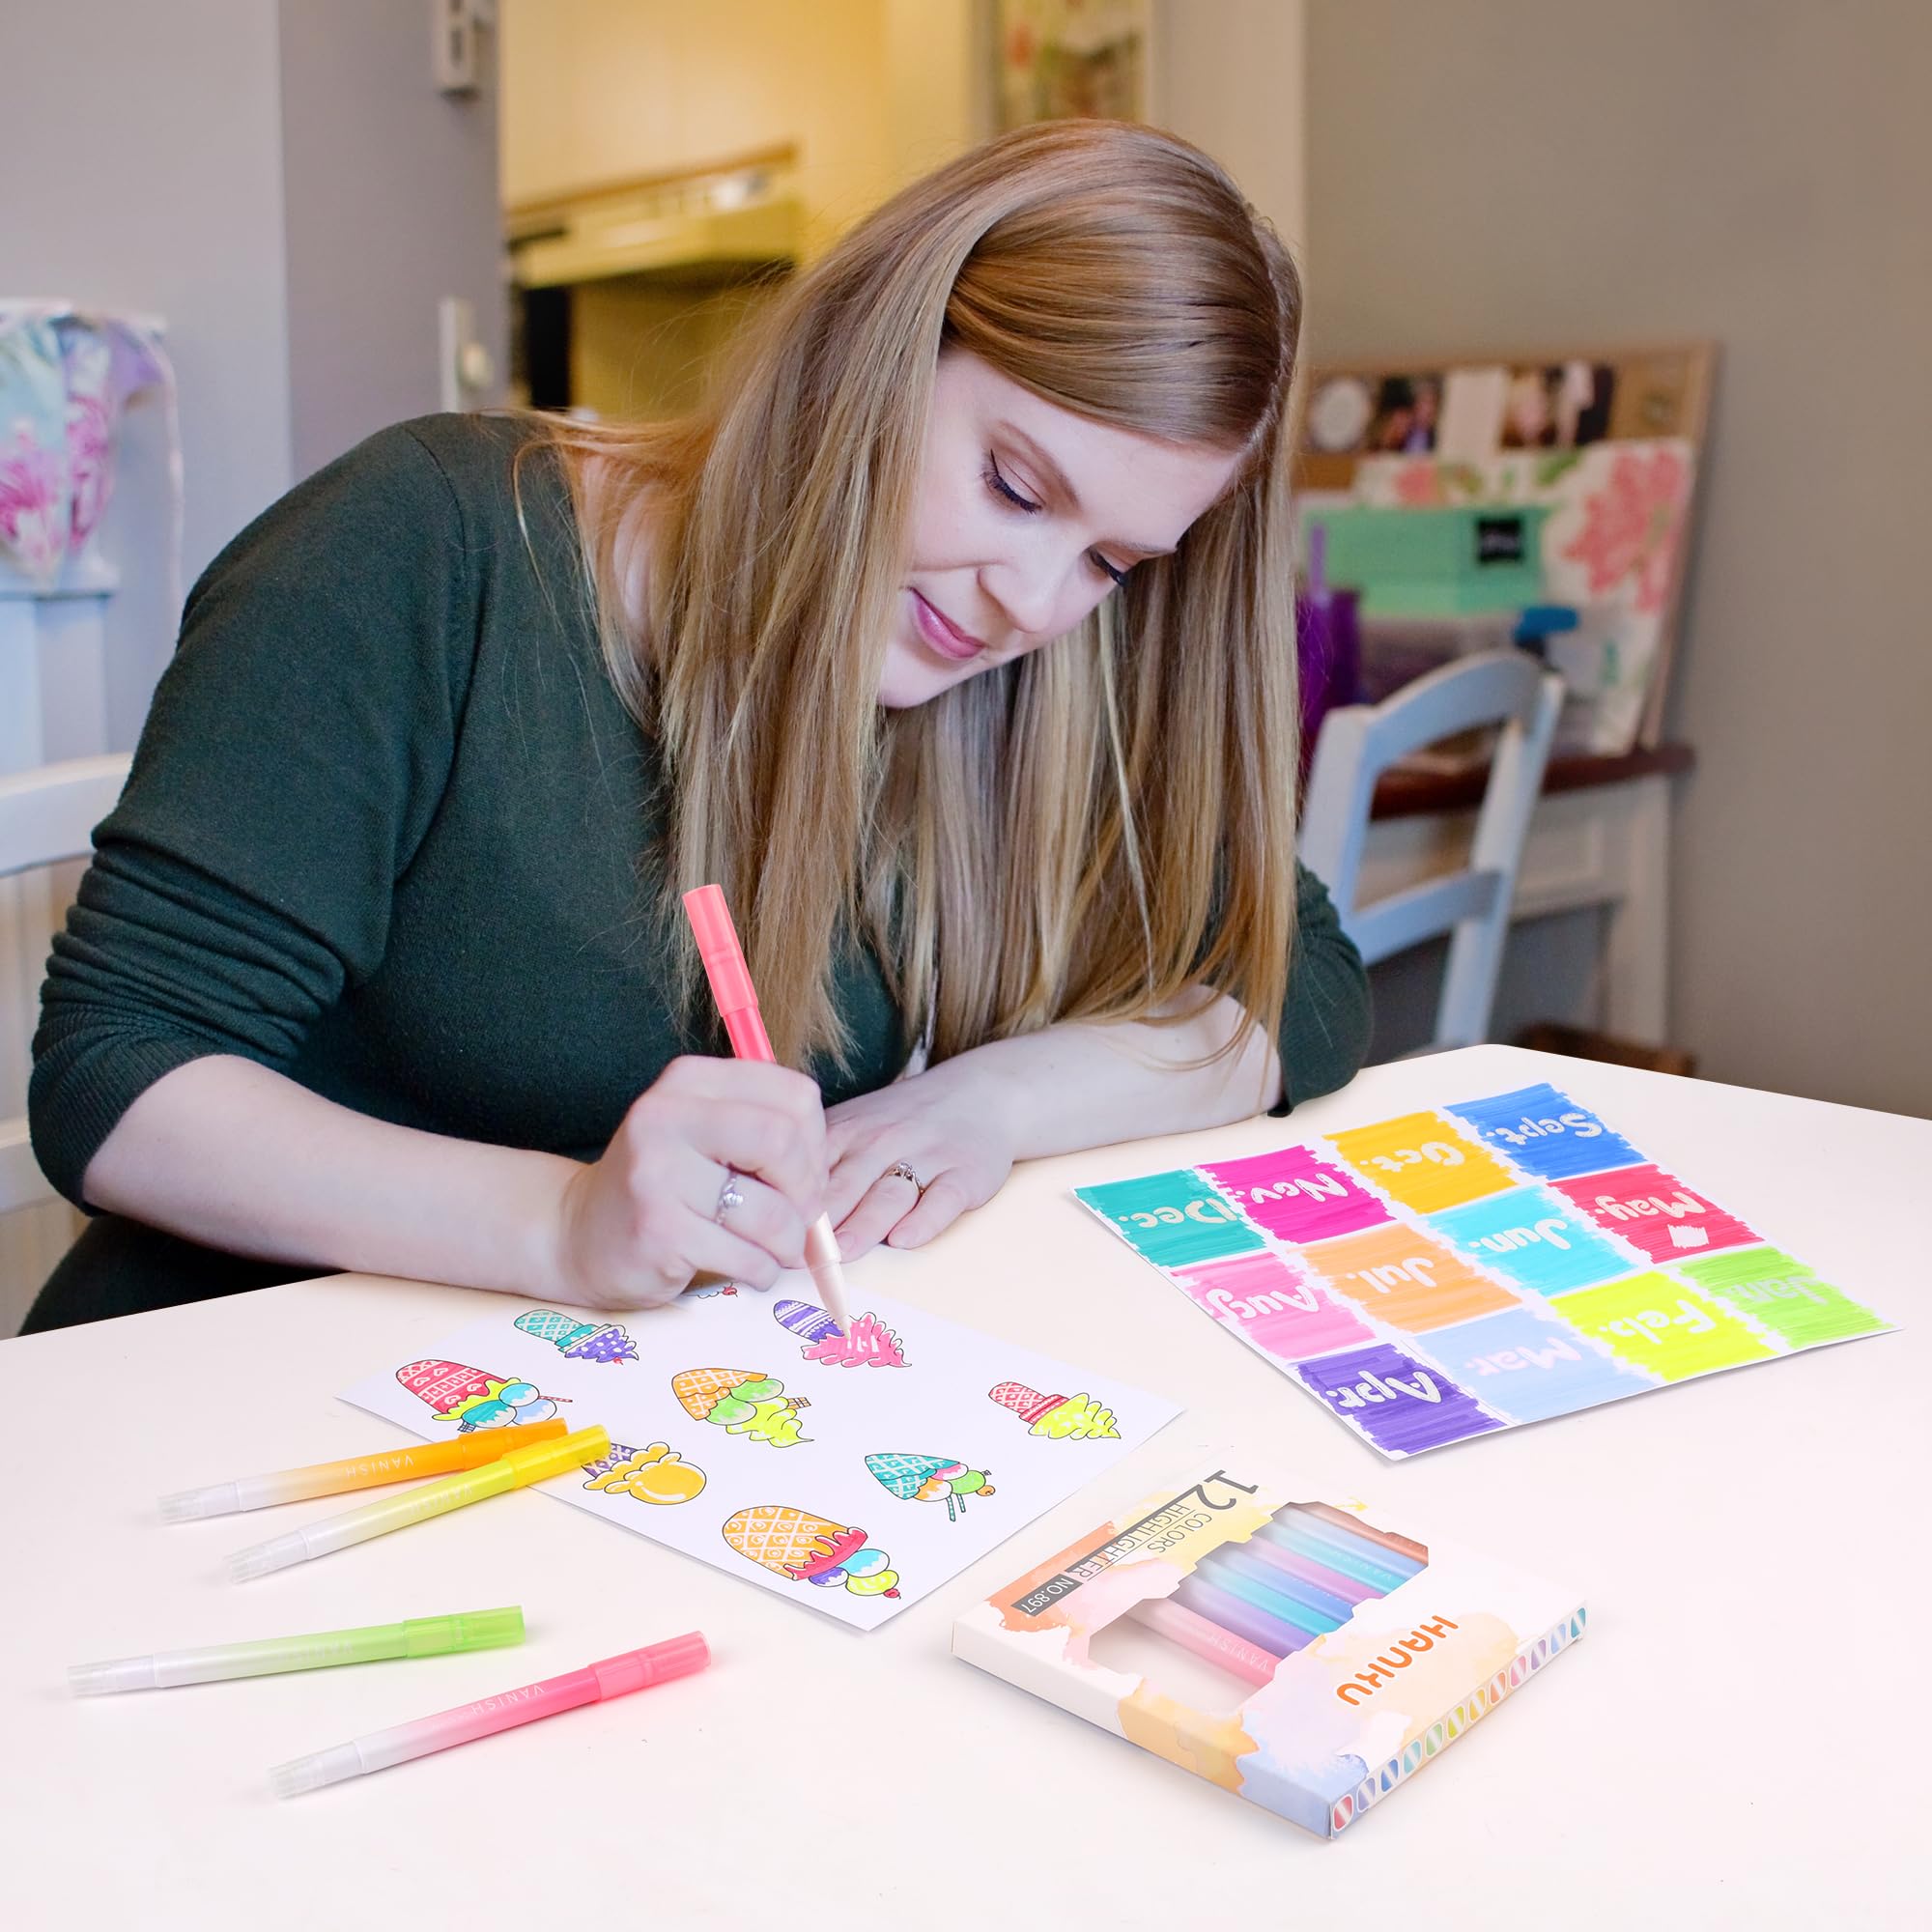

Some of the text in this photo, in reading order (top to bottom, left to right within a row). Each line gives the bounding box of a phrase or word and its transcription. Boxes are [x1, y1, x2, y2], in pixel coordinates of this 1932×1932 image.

[1487, 1112, 1603, 1147] Sept.
[1359, 1141, 1465, 1173] Oct.
[1235, 1172, 1350, 1205] Nov.
[1594, 1191, 1707, 1222] May.
[1120, 1197, 1239, 1229] Dec.
[1468, 1218, 1572, 1251] Jun.
[1346, 1257, 1438, 1294] Jul.
[1597, 1299, 1717, 1345] Feb.
[1465, 1336, 1582, 1377] Mar.
[1325, 1370, 1442, 1408] Apr.
[345, 1454, 414, 1478] VANISH
[1188, 1469, 1260, 1511] 12
[1078, 1503, 1191, 1578] HIGHLIGHTER
[1147, 1512, 1213, 1553] COLORS
[1020, 1577, 1074, 1614] NO.897
[1336, 1614, 1460, 1706] HANKU
[470, 1683, 545, 1717] VANISH
